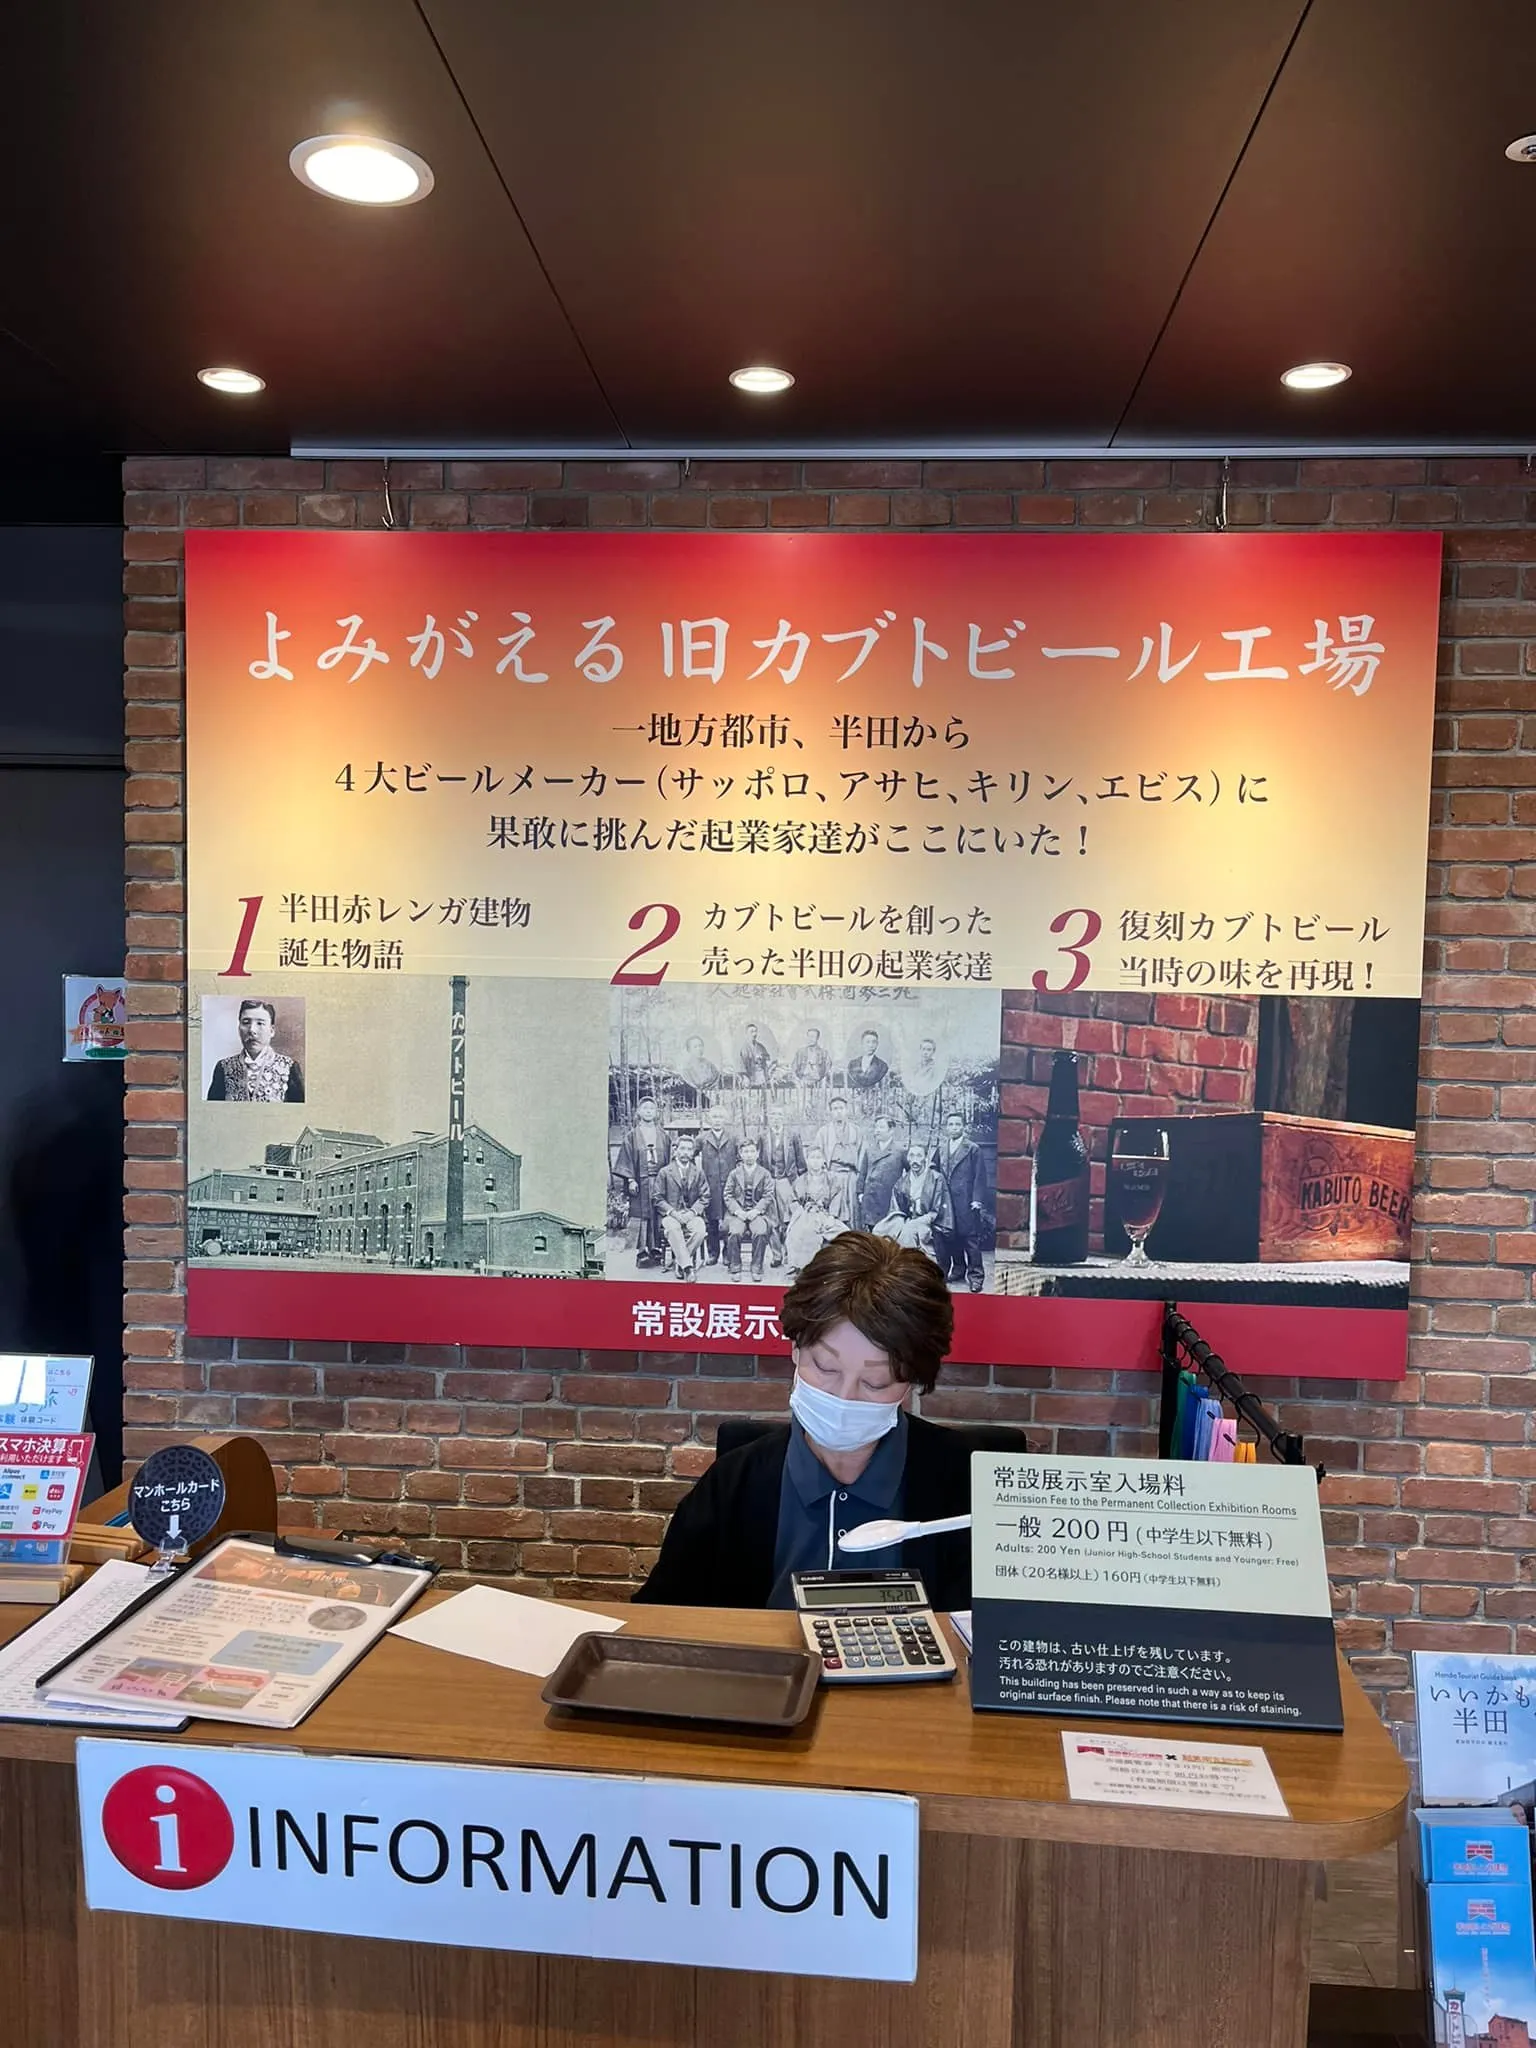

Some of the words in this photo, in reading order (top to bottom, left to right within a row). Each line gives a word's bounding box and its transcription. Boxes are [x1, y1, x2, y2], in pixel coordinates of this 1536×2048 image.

[278, 892, 531, 929] 半田赤レンガ建物
[703, 902, 992, 936] カブトビールを創った
[1119, 910, 1391, 944] 復刻カブトビール
[217, 895, 264, 977] 1
[609, 903, 681, 986] 2
[1032, 908, 1102, 994] 3
[278, 937, 404, 970] 誕生物語
[701, 946, 993, 982] 売った半田の起業家達
[1119, 956, 1373, 991] 当時の味を再現！
[1301, 1176, 1362, 1210] KABUTO
[1369, 1180, 1410, 1224] BEER
[631, 1301, 790, 1340] 常設展示
[134, 1478, 220, 1498] マンホールカード
[993, 1466, 1186, 1497] 常設展示室入場料
[160, 1497, 191, 1512] こちら
[996, 1493, 1047, 1504] Admission
[1051, 1495, 1067, 1505] Fee
[1070, 1497, 1080, 1506] to
[1083, 1498, 1098, 1507] the
[1101, 1497, 1154, 1509] Permanent
[1157, 1500, 1207, 1511] Collection
[1209, 1502, 1259, 1513] Exhibition
[1262, 1505, 1297, 1516] Rooms
[1037, 1545, 1057, 1554] 200
[1059, 1546, 1081, 1556] Yen
[1174, 1553, 1213, 1562] Students
[1000, 1676, 1019, 1686] This
[1022, 1678, 1060, 1690] building
[1062, 1680, 1079, 1689] has
[1081, 1681, 1105, 1691] been
[1107, 1683, 1154, 1694] preserved
[1156, 1685, 1165, 1694] in
[1168, 1686, 1189, 1696] such
[1192, 1688, 1198, 1696] a
[1200, 1689, 1220, 1699] way
[1222, 1690, 1233, 1698] as
[1235, 1689, 1245, 1699] to
[1248, 1690, 1271, 1701] keep
[1273, 1691, 1285, 1701] its
[1000, 1690, 1035, 1701] original
[1037, 1692, 1072, 1702] surface
[1074, 1693, 1103, 1704] finish.
[1105, 1695, 1136, 1706] Please
[1138, 1697, 1160, 1707] note
[1162, 1698, 1180, 1708] that
[1183, 1699, 1208, 1710] there
[1210, 1701, 1218, 1711] is
[1229, 1703, 1246, 1712] risk
[1248, 1703, 1258, 1713] of
[1260, 1705, 1302, 1717] staining.
[1453, 1707, 1508, 1734] 半田
[248, 1806, 890, 1920] INFORMATION
